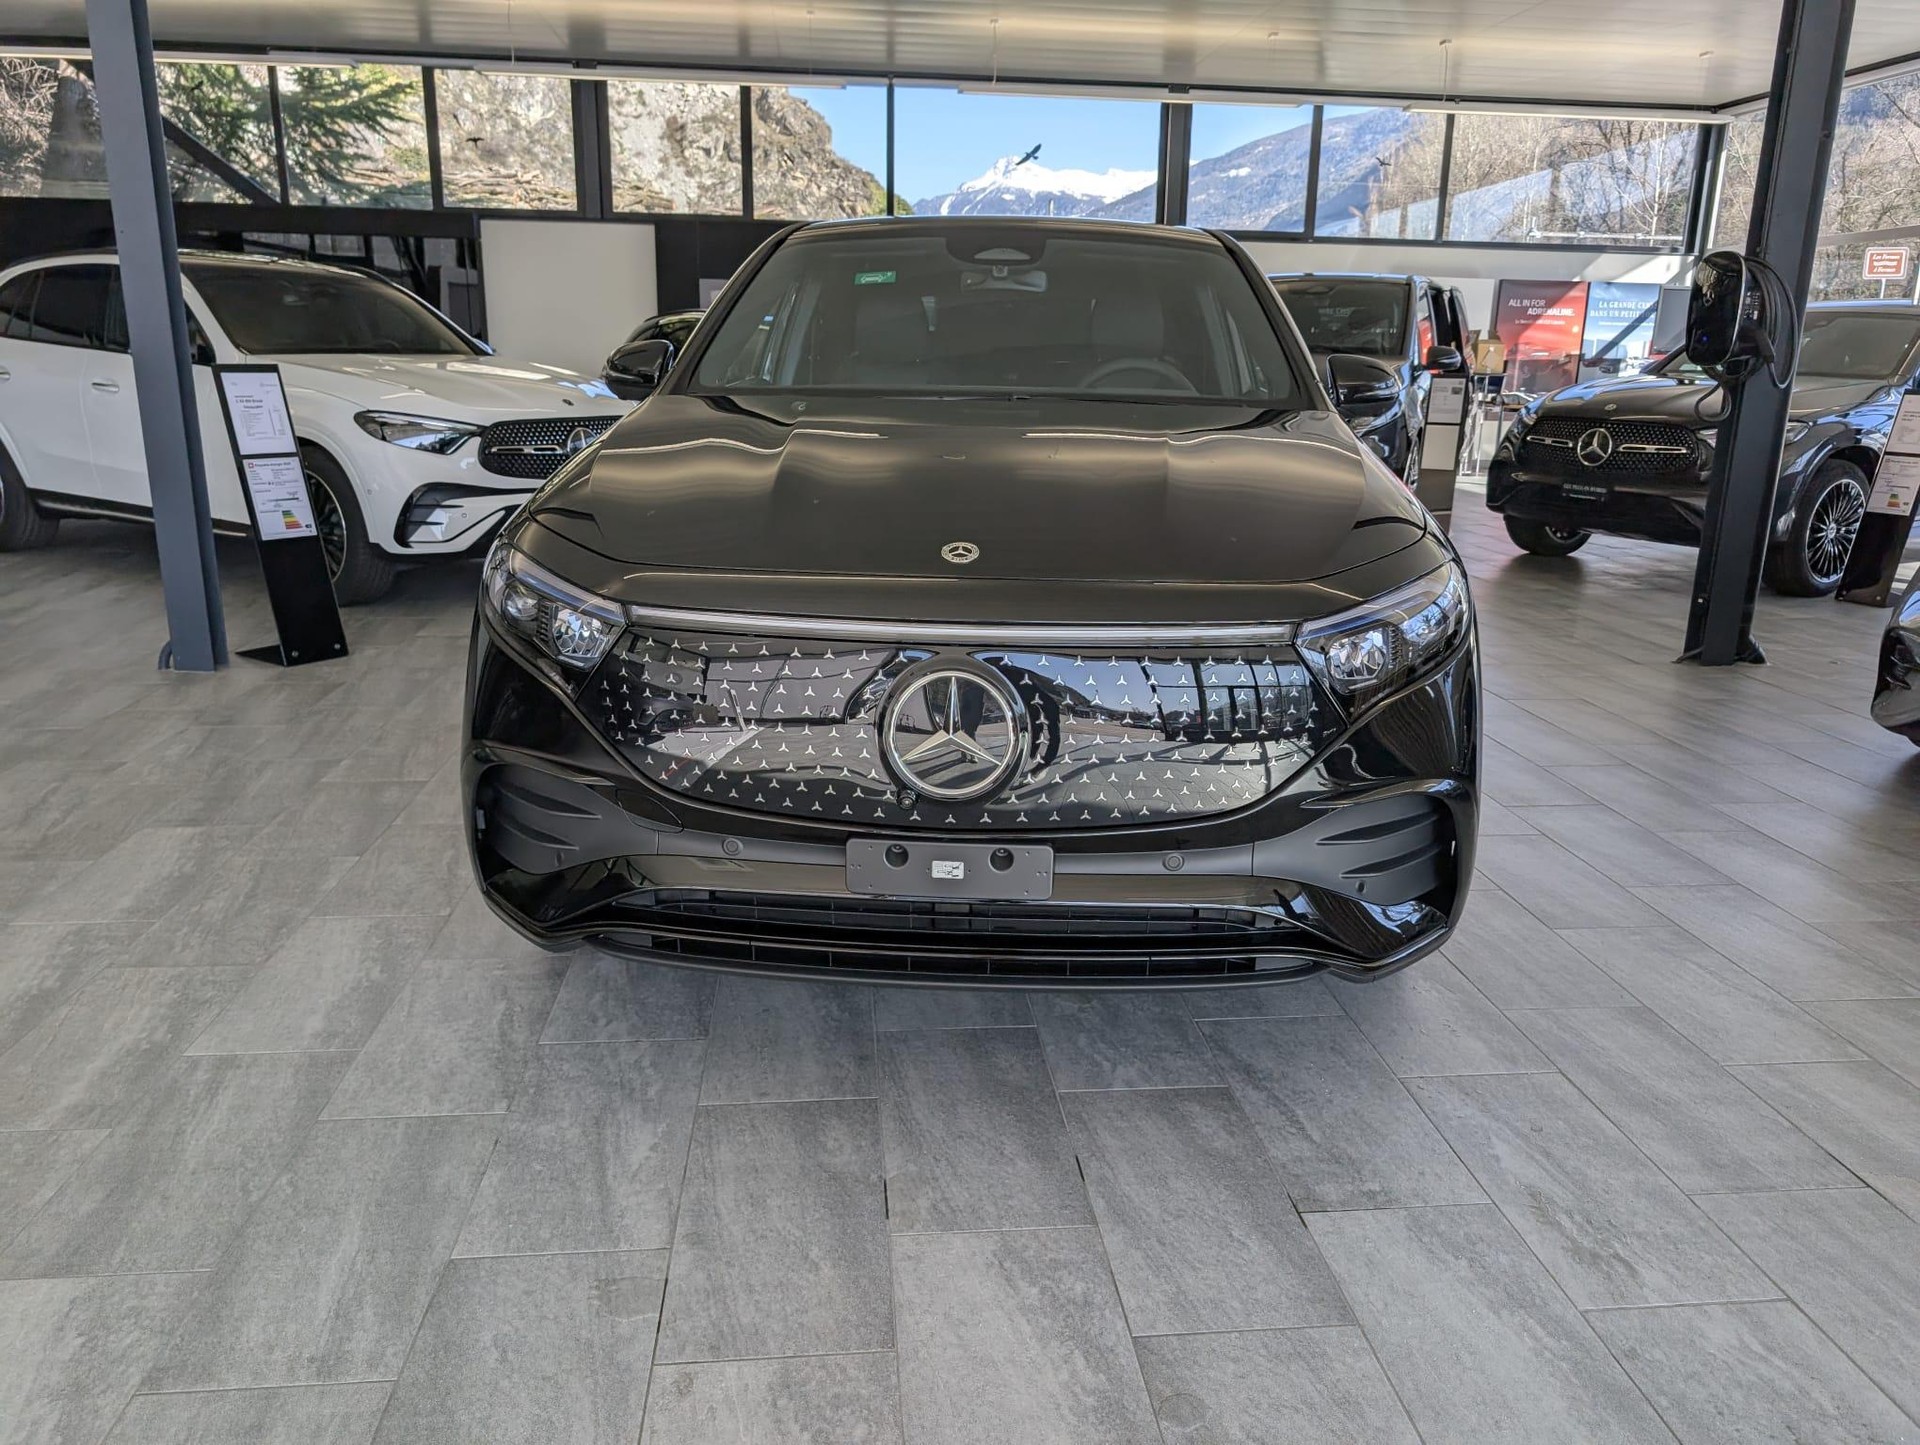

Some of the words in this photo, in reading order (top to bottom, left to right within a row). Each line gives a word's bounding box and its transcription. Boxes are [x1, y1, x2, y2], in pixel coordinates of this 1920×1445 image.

[1508, 298, 1521, 307] ALL
[1522, 299, 1530, 307] IN
[1531, 299, 1546, 307] FOR
[1599, 300, 1608, 308] LA
[1609, 301, 1636, 309] GRANDE
